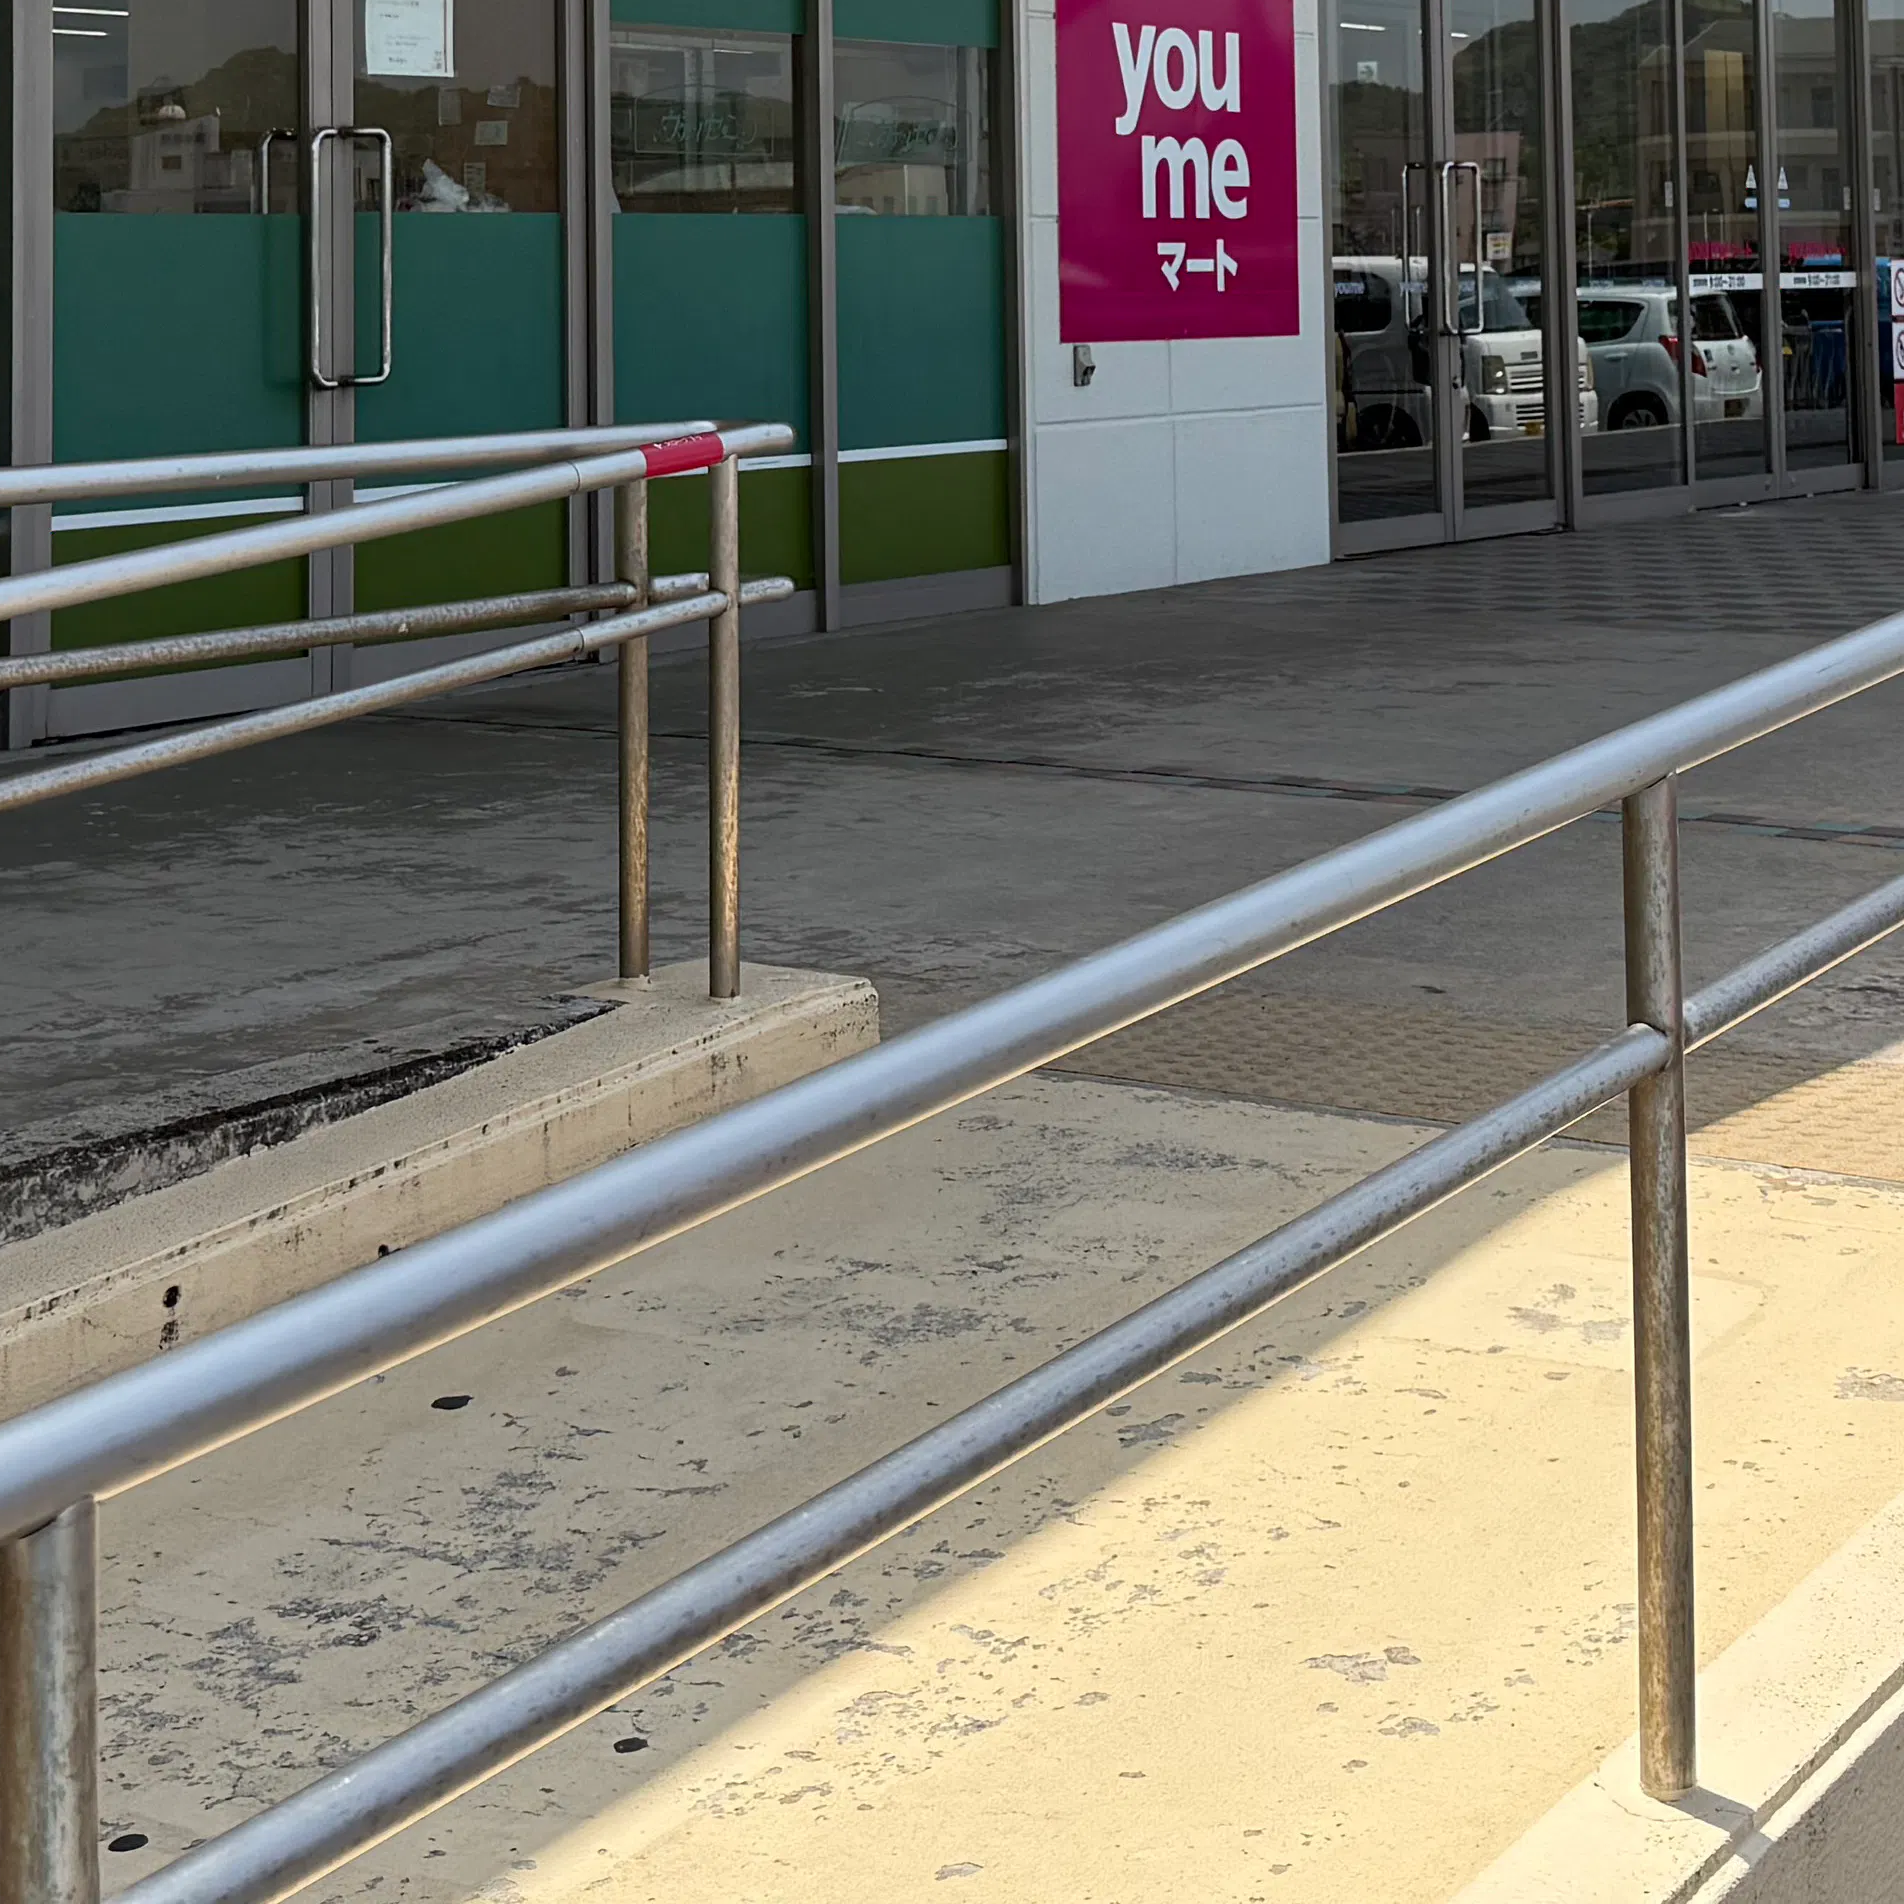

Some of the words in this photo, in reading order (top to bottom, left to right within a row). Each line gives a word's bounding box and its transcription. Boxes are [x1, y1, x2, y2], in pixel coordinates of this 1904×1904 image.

[1112, 21, 1241, 137] you
[1140, 134, 1251, 220] me
[1156, 238, 1238, 293] マート
